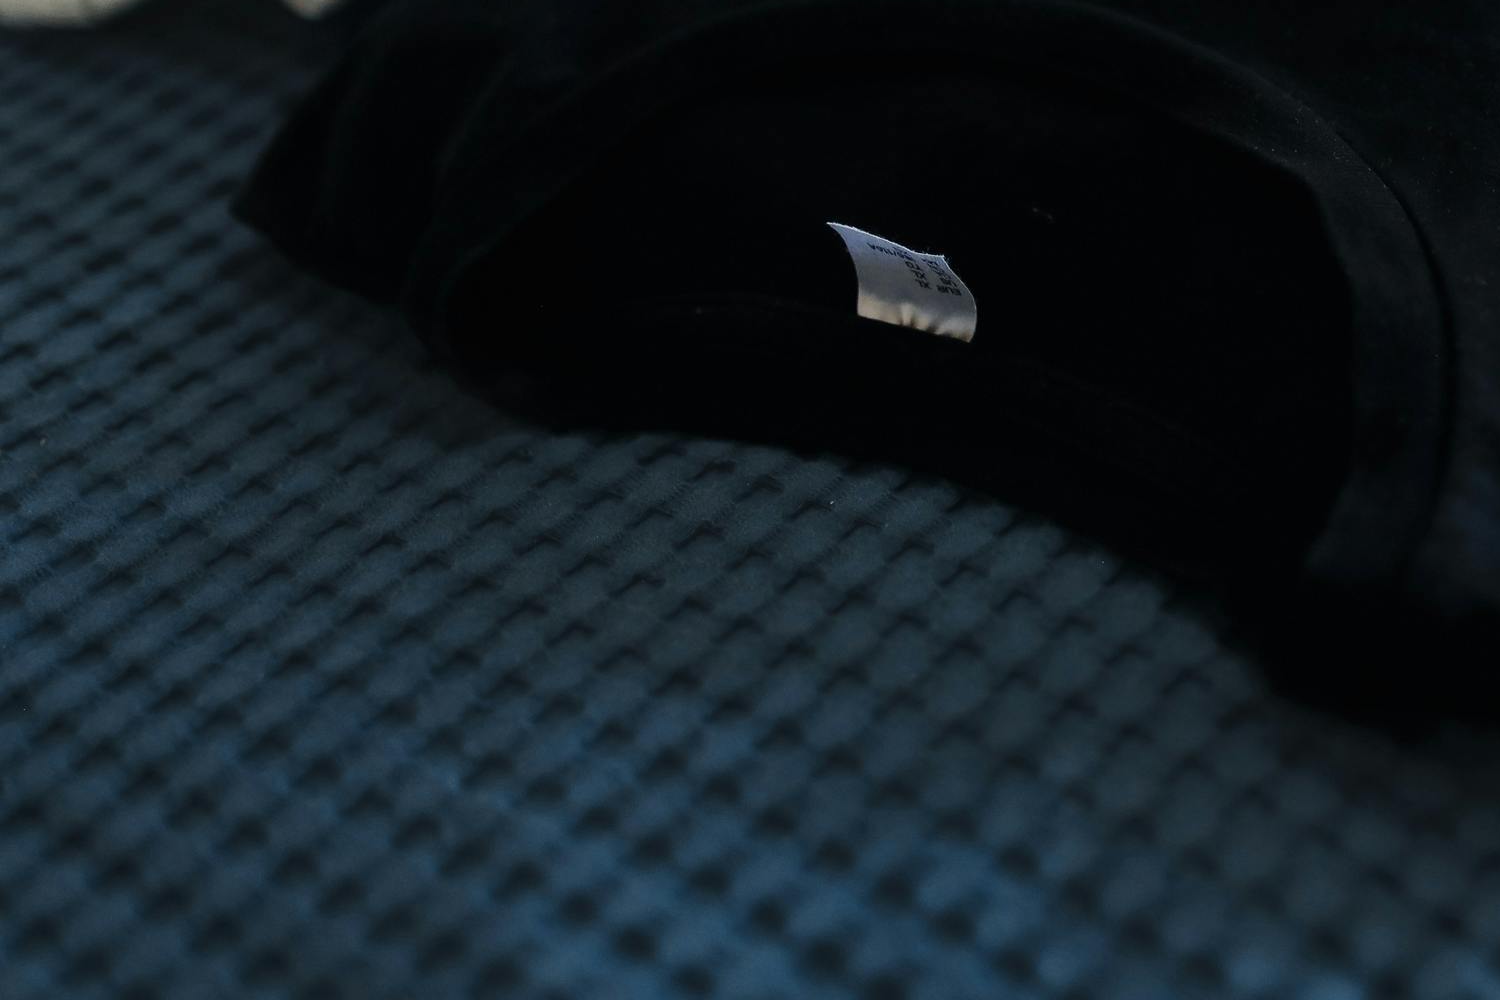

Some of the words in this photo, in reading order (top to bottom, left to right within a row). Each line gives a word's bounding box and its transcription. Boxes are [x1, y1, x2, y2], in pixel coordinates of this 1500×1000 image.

[910, 270, 927, 279] XL
[916, 279, 932, 289] XL
[936, 285, 961, 295] EUR
